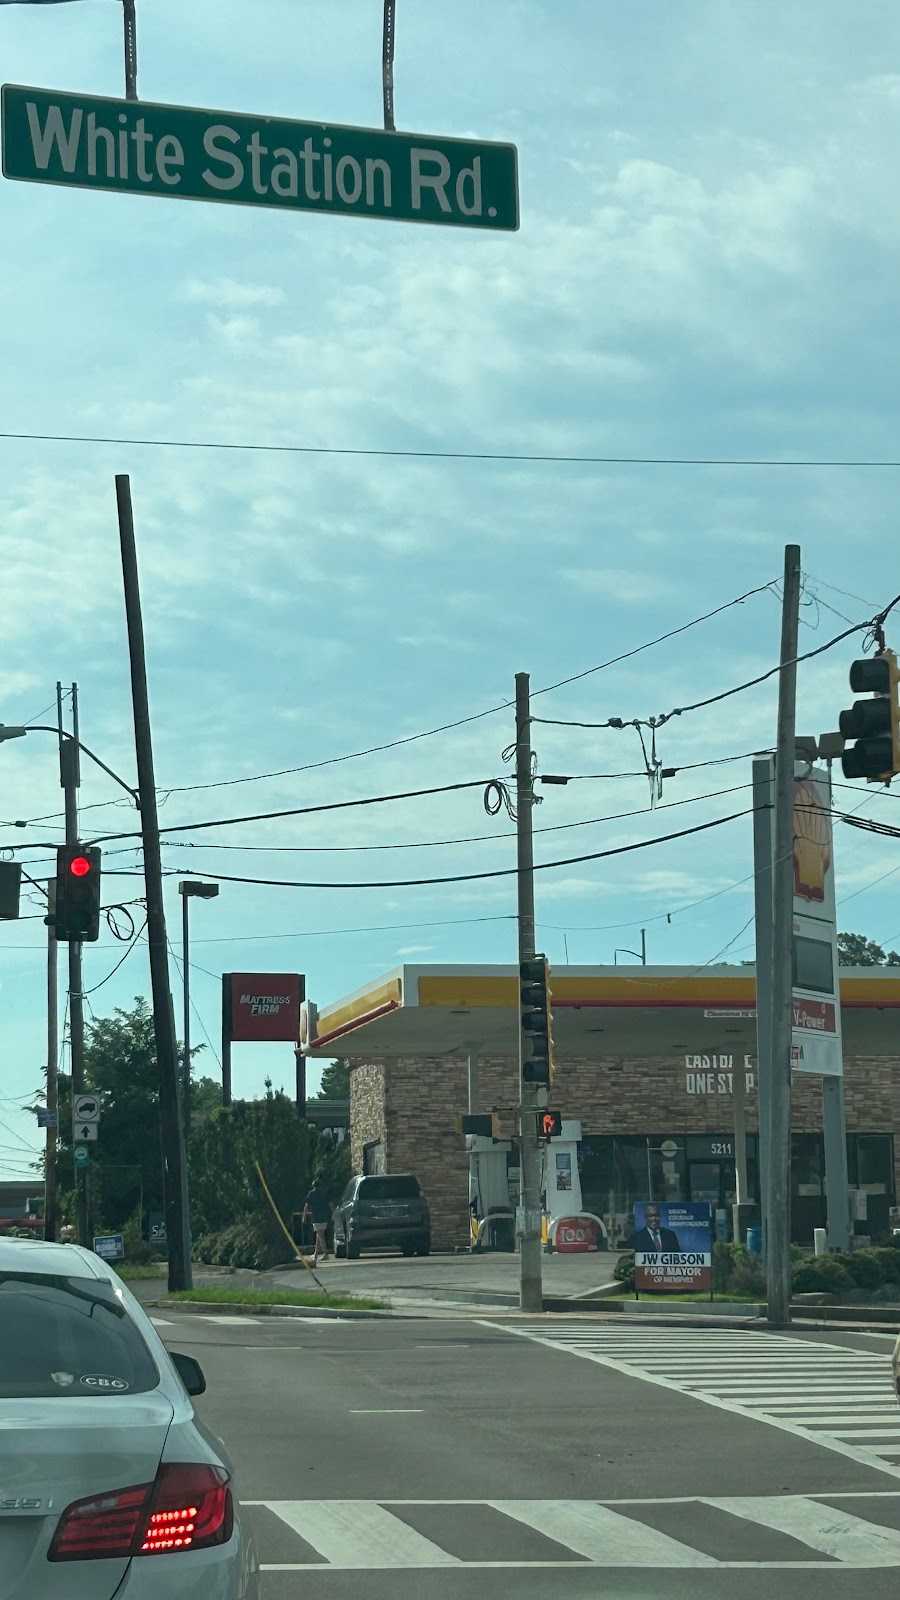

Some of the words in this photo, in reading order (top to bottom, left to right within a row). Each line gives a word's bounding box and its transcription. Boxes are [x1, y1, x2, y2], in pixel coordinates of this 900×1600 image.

[26, 102, 185, 186] White
[201, 124, 392, 208] Station
[410, 147, 498, 218] Rd.
[240, 994, 291, 1004] MATTRESS
[251, 1004, 280, 1016] FIRM
[793, 1008, 825, 1030] V-Power
[686, 1073, 715, 1094] ONE
[717, 1073, 755, 1094] STP
[711, 1143, 731, 1155] 5211
[641, 1253, 658, 1265] JW
[661, 1253, 705, 1265] GIBSON
[644, 1266, 664, 1276] FOR
[667, 1266, 701, 1276] MAYOR
